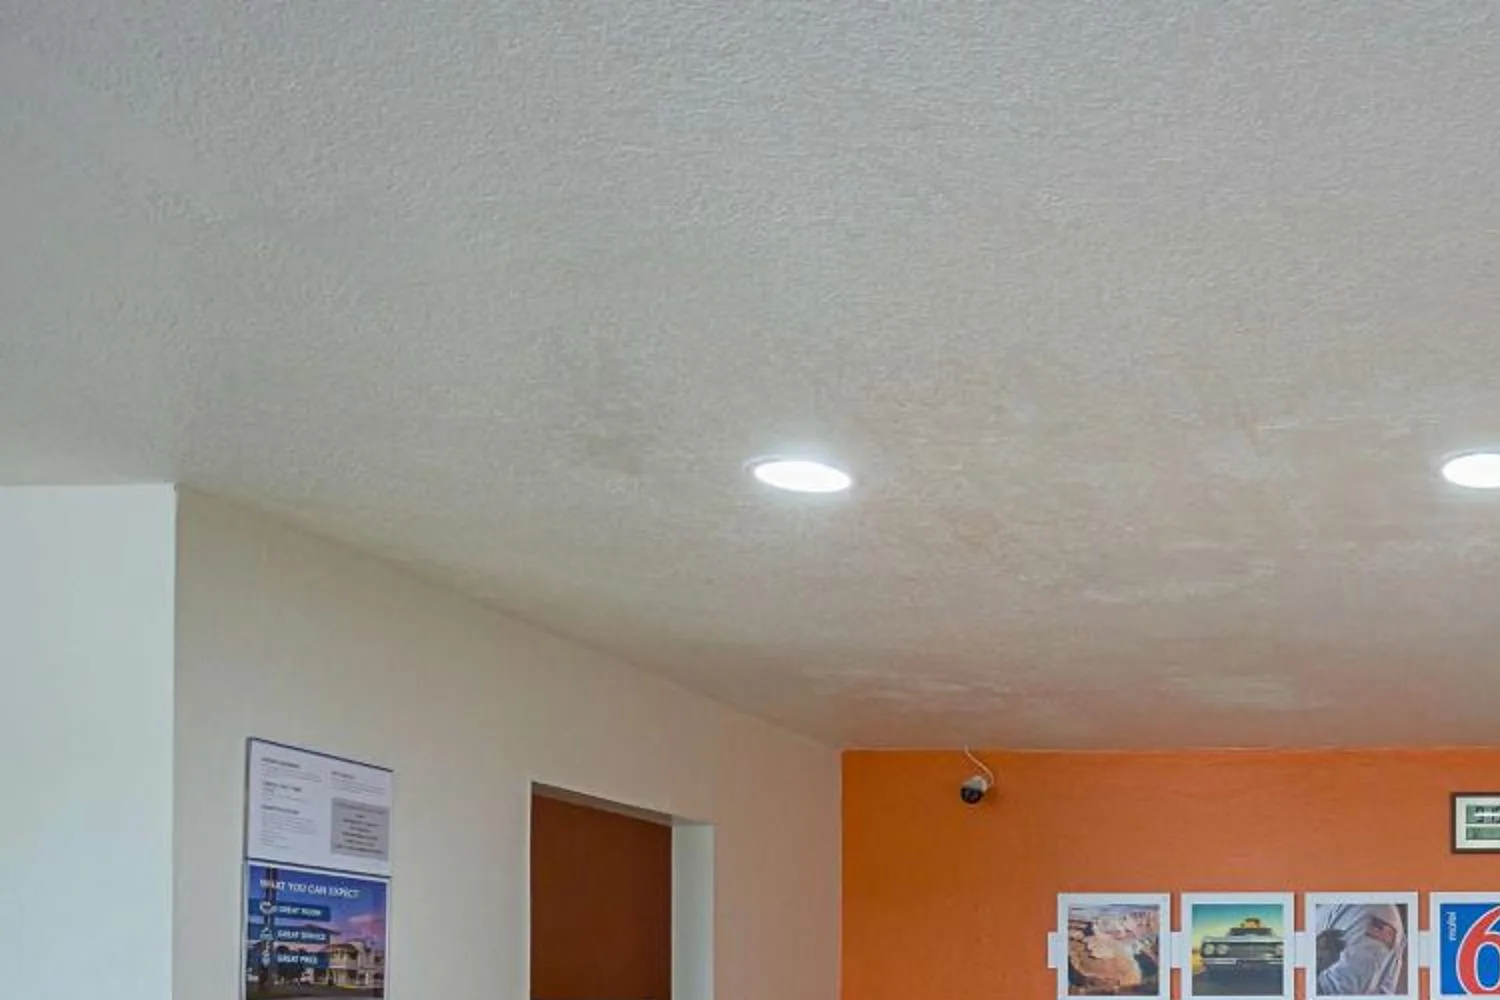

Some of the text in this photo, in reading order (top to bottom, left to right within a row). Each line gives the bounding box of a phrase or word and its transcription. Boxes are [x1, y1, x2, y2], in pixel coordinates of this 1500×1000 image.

[288, 882, 306, 893] YOU
[307, 885, 327, 896] CAN
[328, 887, 360, 898] EXPECT
